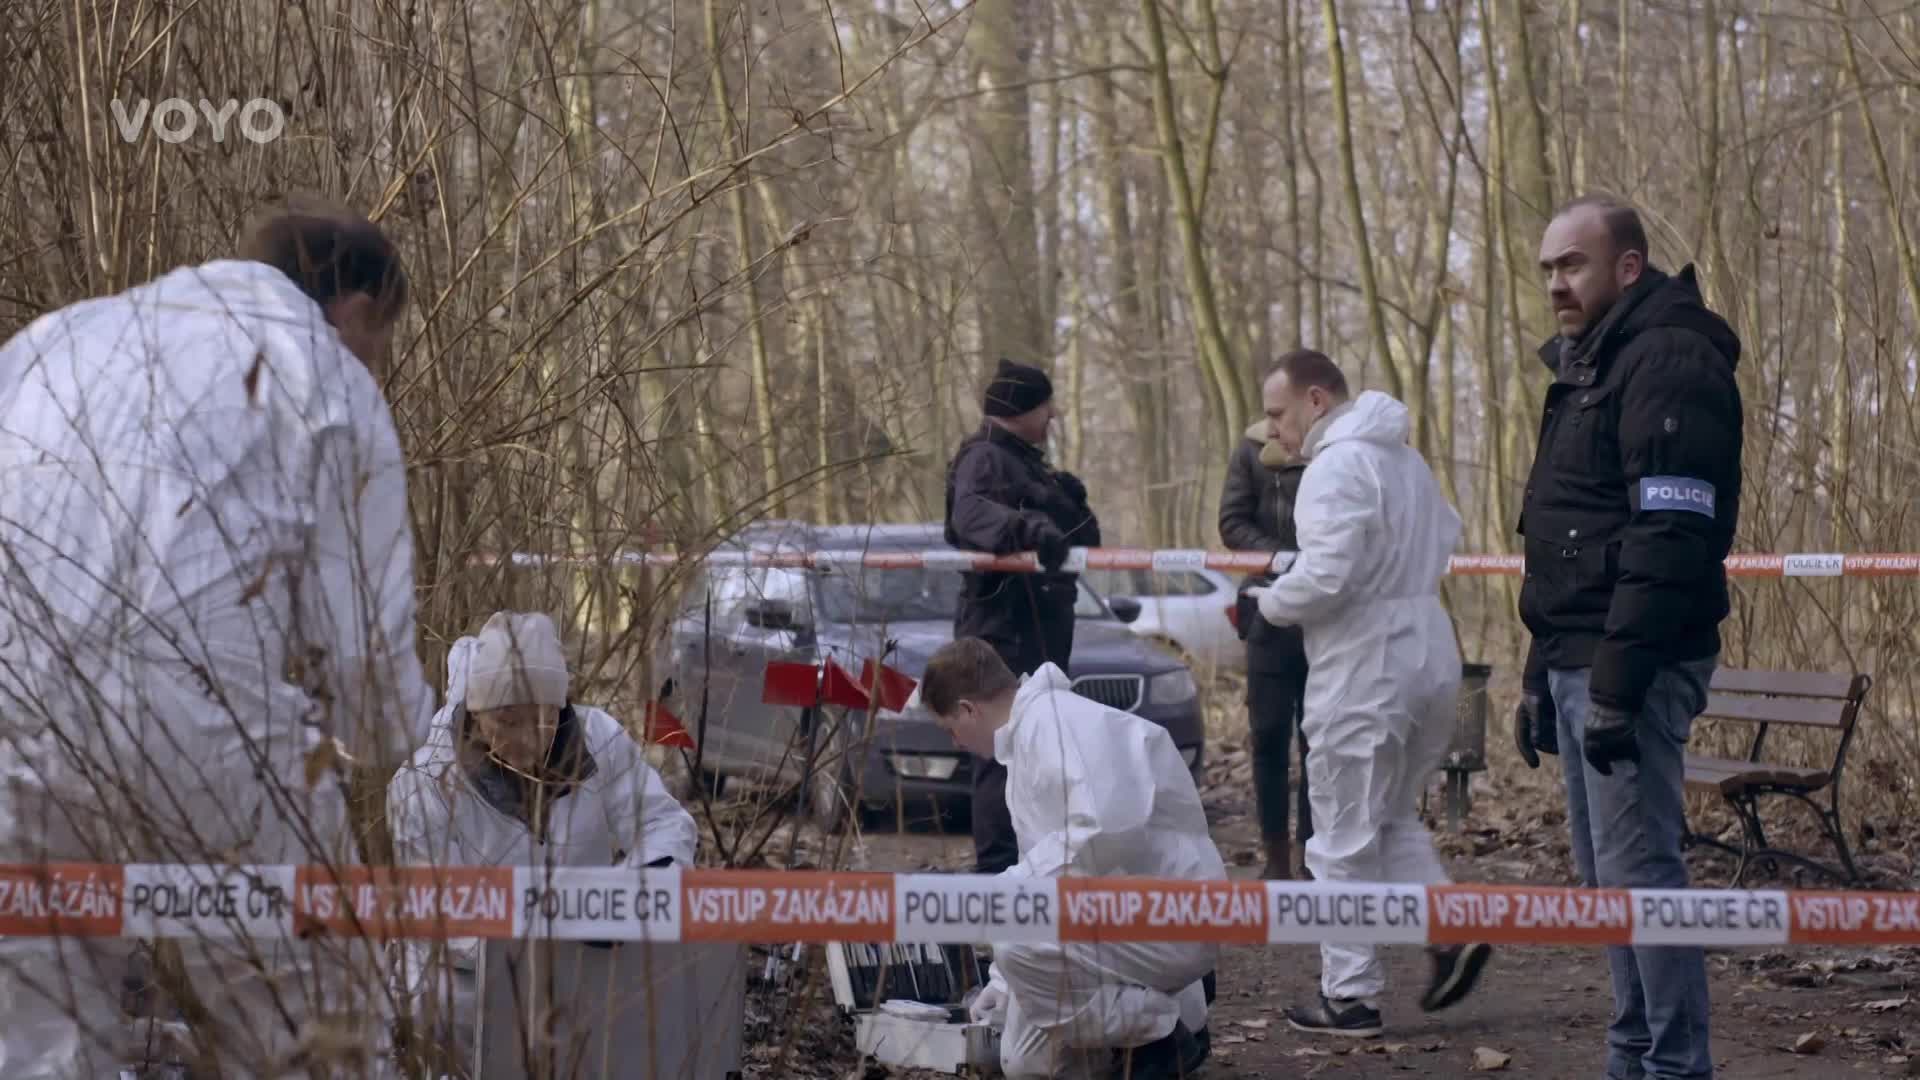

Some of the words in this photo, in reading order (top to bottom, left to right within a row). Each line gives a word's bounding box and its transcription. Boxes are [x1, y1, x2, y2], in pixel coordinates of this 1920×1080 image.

[1646, 486, 1712, 508] POLICIE
[133, 883, 238, 918] POLICIE
[523, 887, 627, 921] POLICIE
[687, 887, 765, 923] VSTUP
[771, 880, 889, 924] ZAKÁZÁN
[905, 891, 1005, 924] POLICIE
[1016, 884, 1051, 924] ČR
[1066, 890, 1142, 926] VSTUP
[1147, 882, 1262, 927] ZAKÁZÁN
[1278, 893, 1377, 927] POLICIE
[1383, 887, 1421, 927] ČR
[1435, 894, 1510, 927] VSTUP
[1514, 886, 1627, 928] ZAKÁZÁN
[1643, 899, 1738, 929] POLICIE
[1747, 890, 1781, 929] ČR
[1793, 896, 1868, 930] VSTUP
